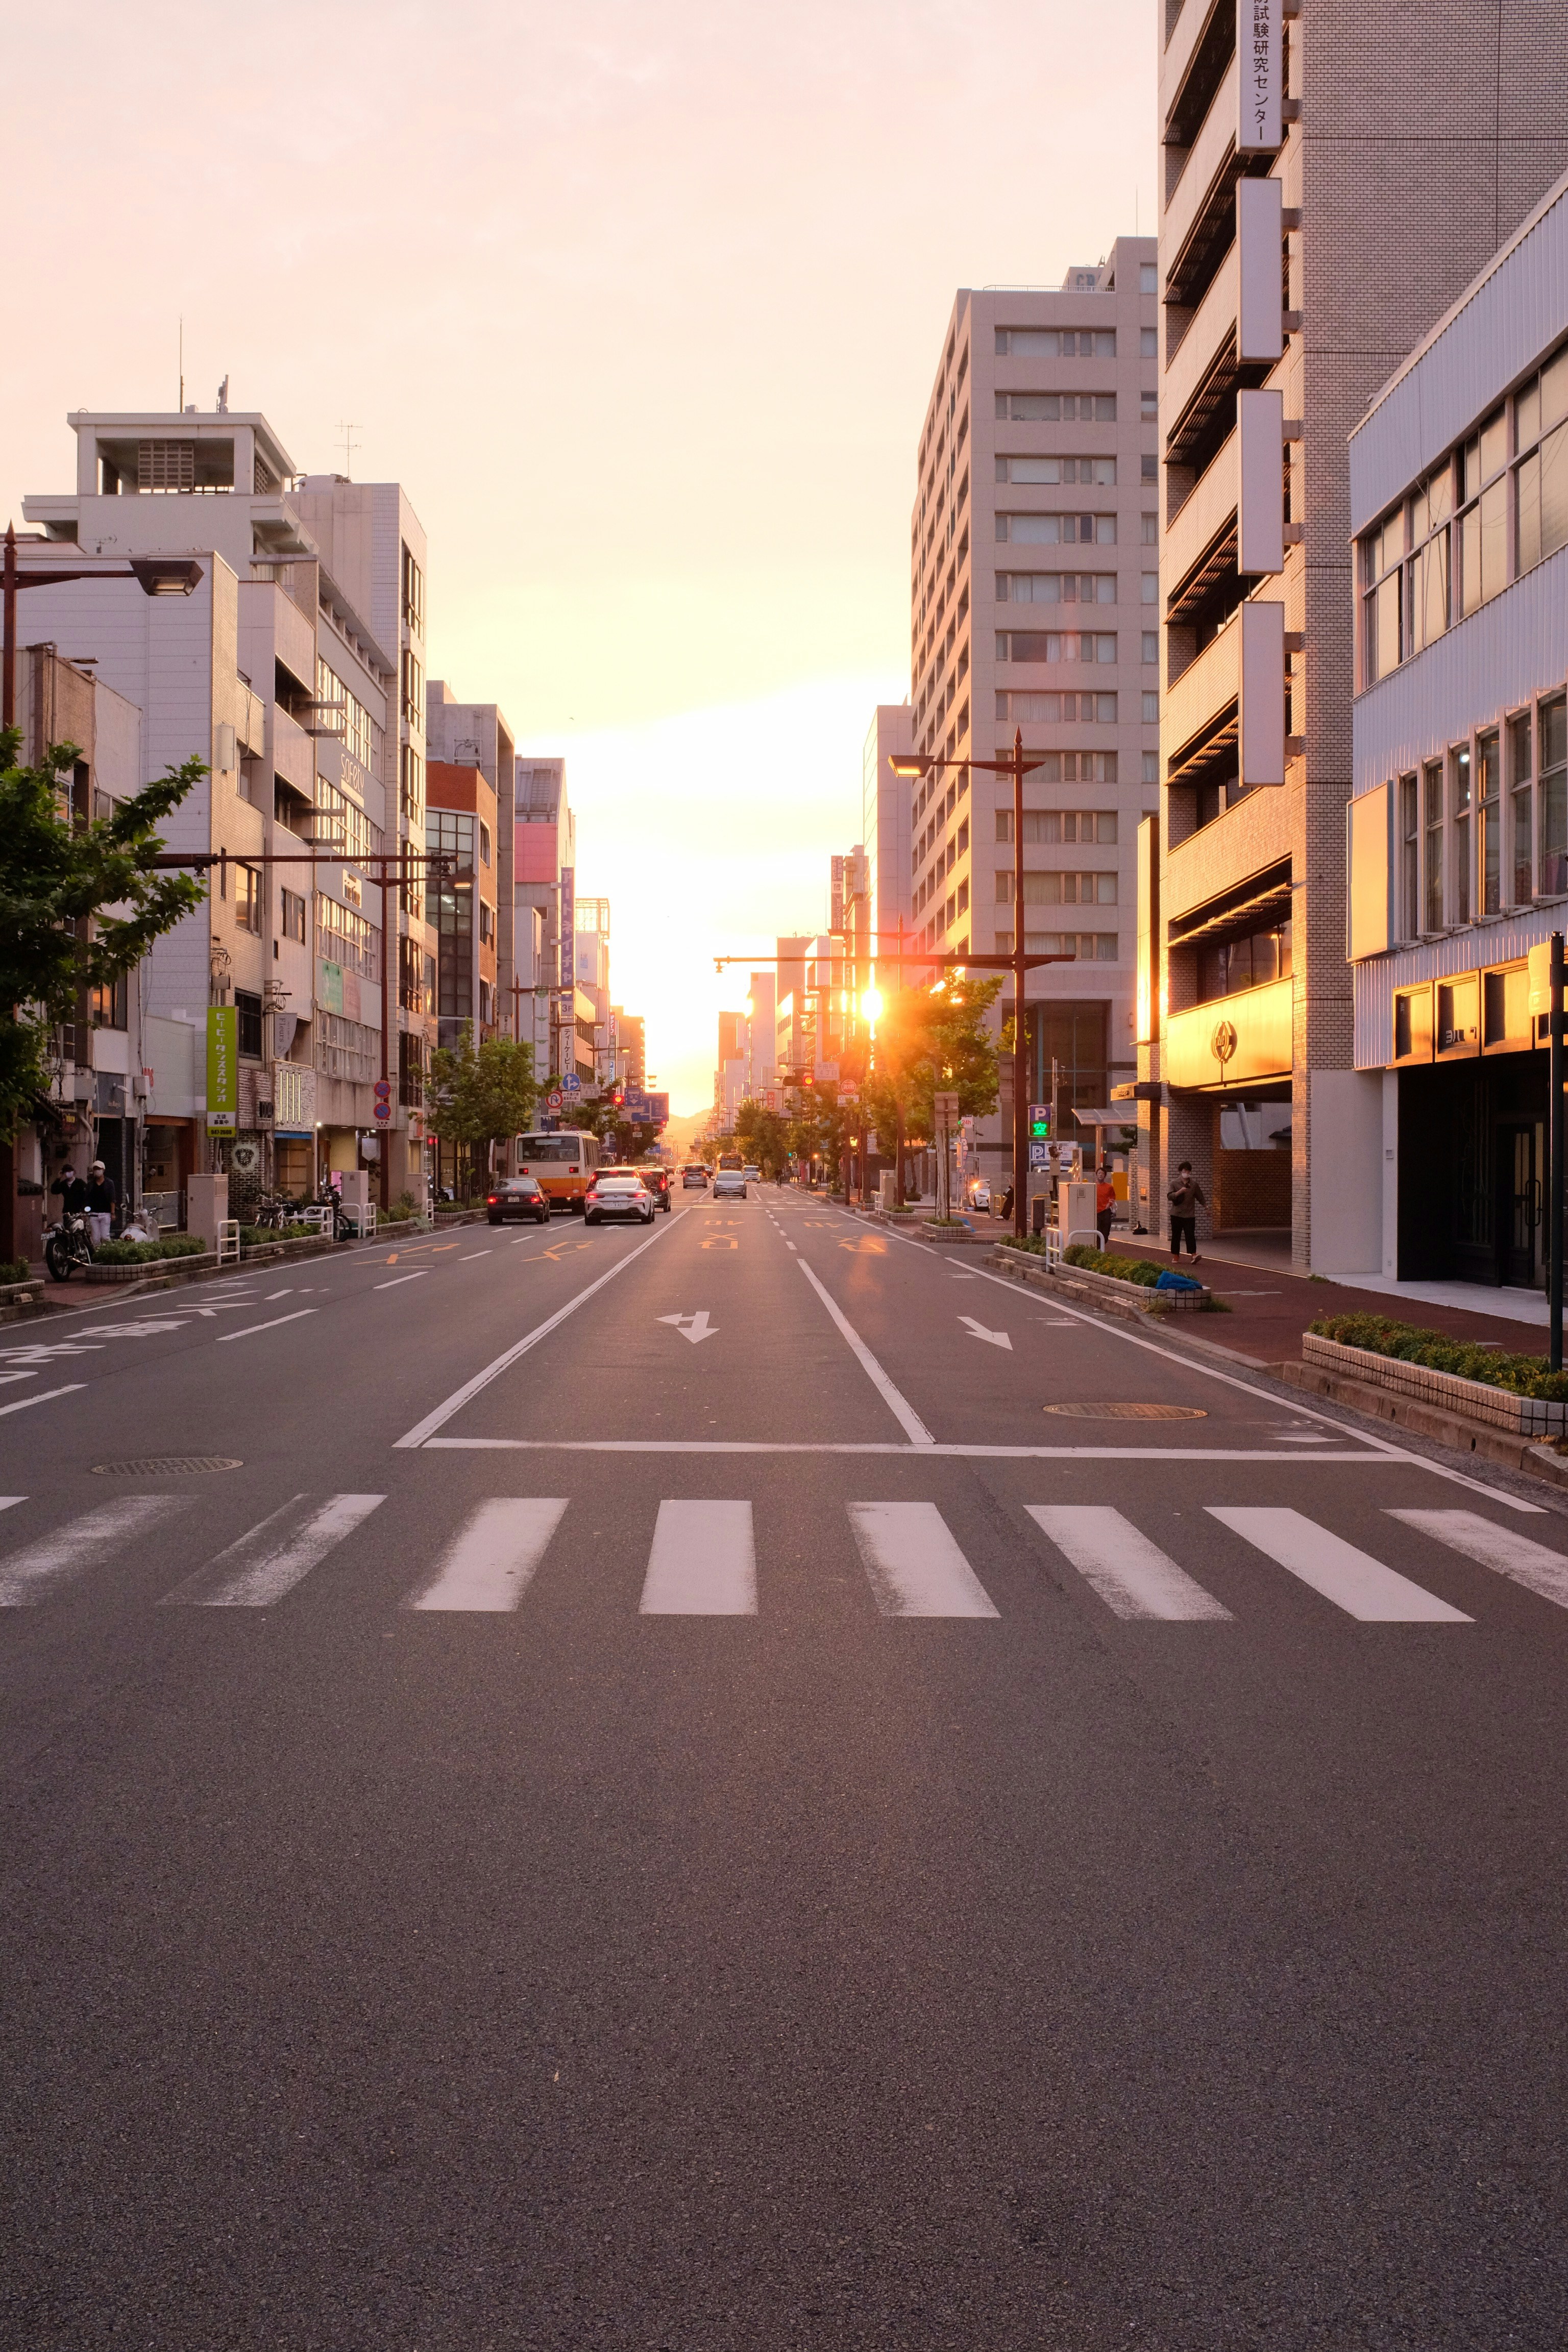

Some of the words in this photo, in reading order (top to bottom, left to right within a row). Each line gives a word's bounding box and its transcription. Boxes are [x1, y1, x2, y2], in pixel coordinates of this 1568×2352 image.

[1253, 0, 1269, 140] 試験研究センター
[562, 1004, 573, 1013] 3F
[1035, 1107, 1047, 1121] P
[1033, 1122, 1047, 1135] 空
